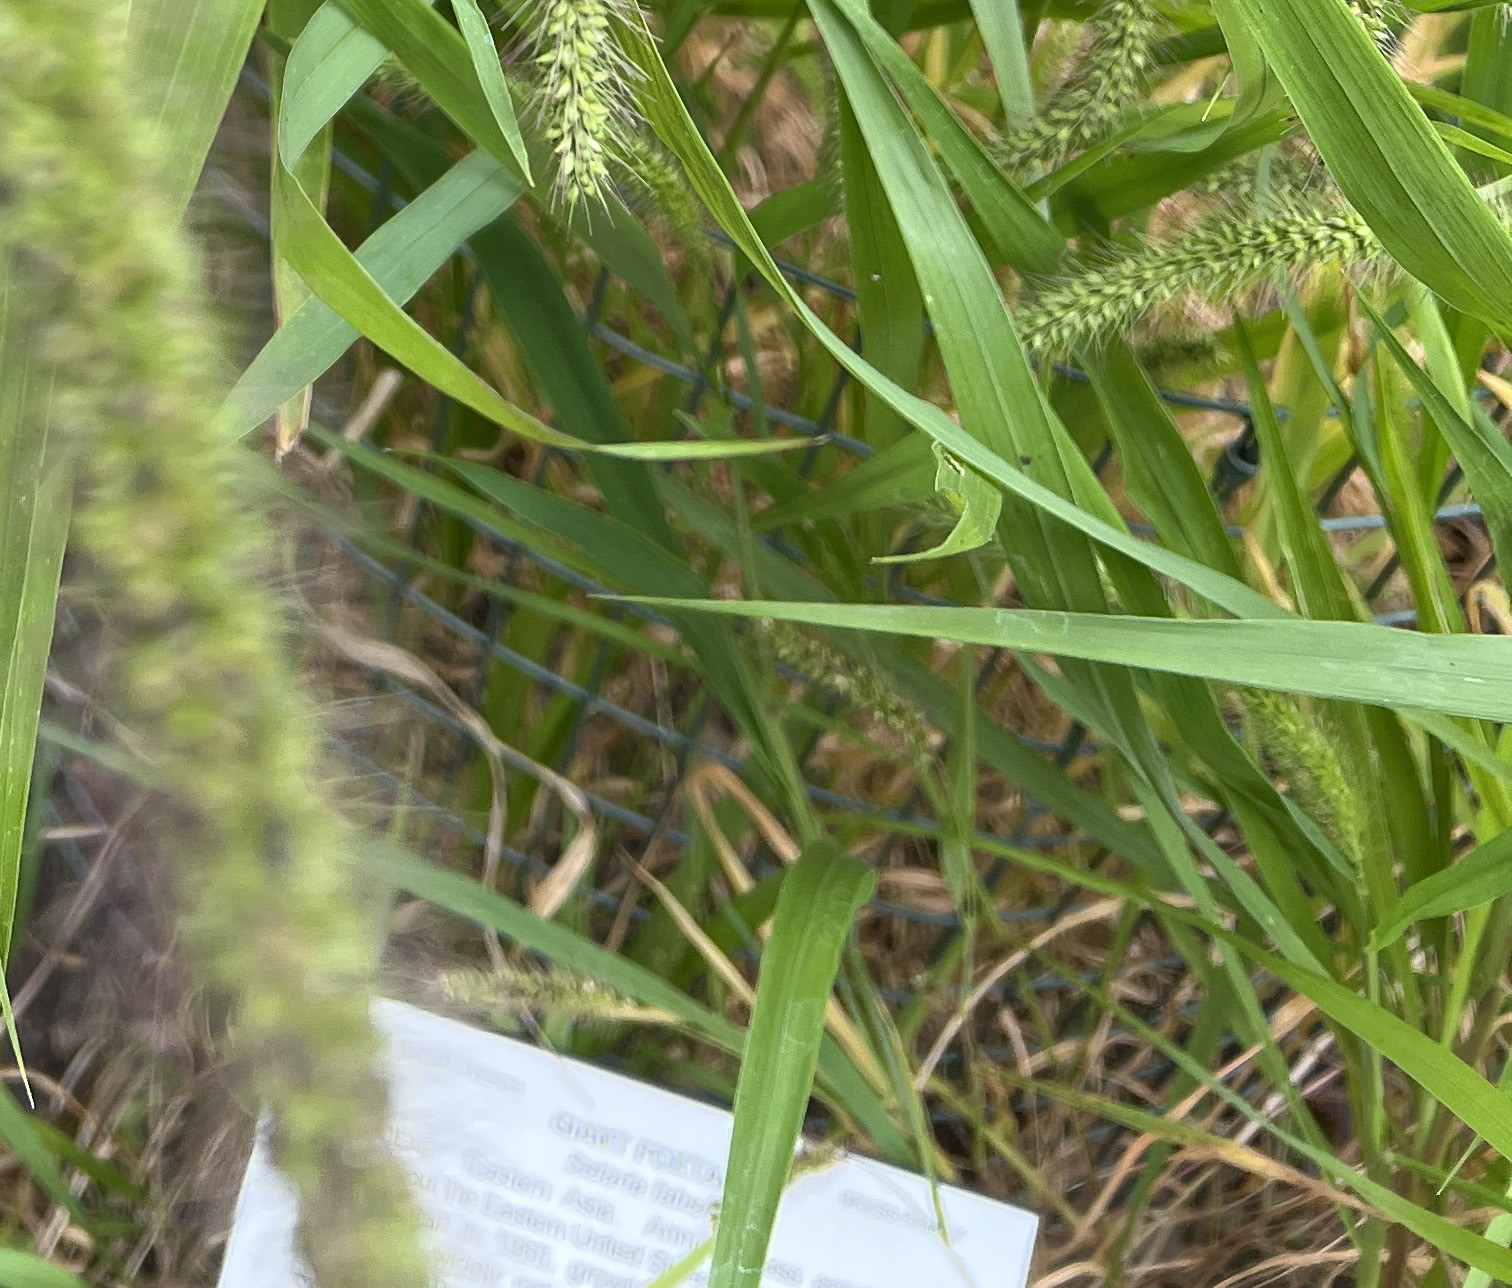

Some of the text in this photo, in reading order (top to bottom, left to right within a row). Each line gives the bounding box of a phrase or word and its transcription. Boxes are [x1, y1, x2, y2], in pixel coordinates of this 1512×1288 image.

[551, 1112, 723, 1186] GIANT FOXTA
[462, 1151, 552, 1201] Eastern
[482, 1191, 566, 1240] Eastern
